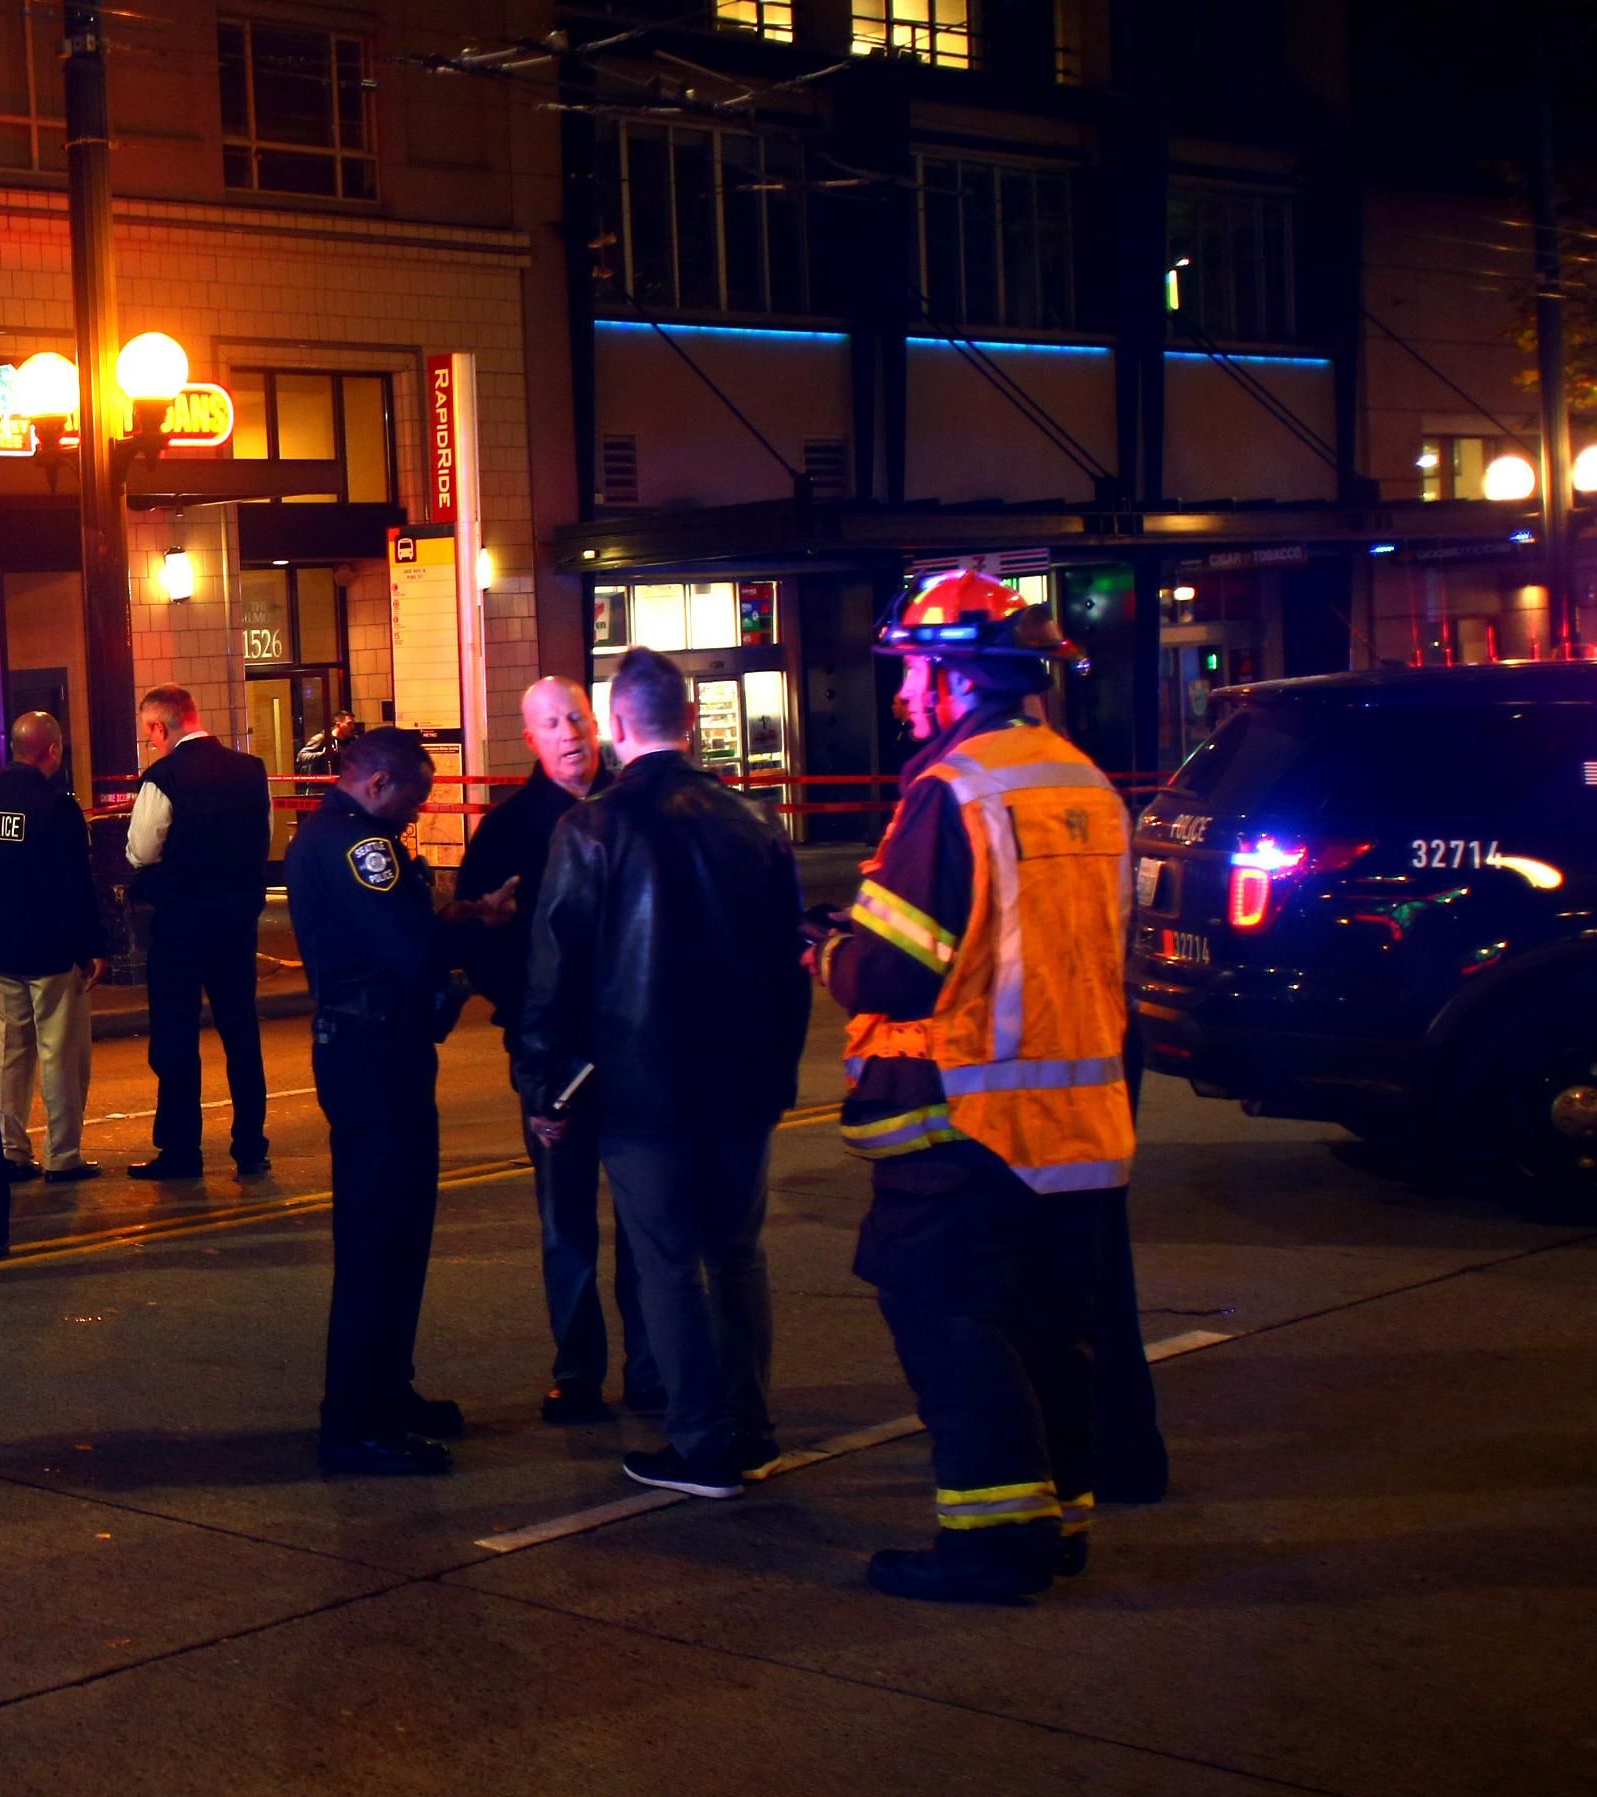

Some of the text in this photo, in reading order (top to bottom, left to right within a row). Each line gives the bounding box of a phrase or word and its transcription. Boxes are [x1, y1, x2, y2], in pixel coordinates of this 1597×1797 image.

[243, 628, 283, 659] 1526
[1170, 813, 1214, 843] POLICE
[1411, 839, 1502, 870] 32714
[368, 869, 395, 884] POLICE
